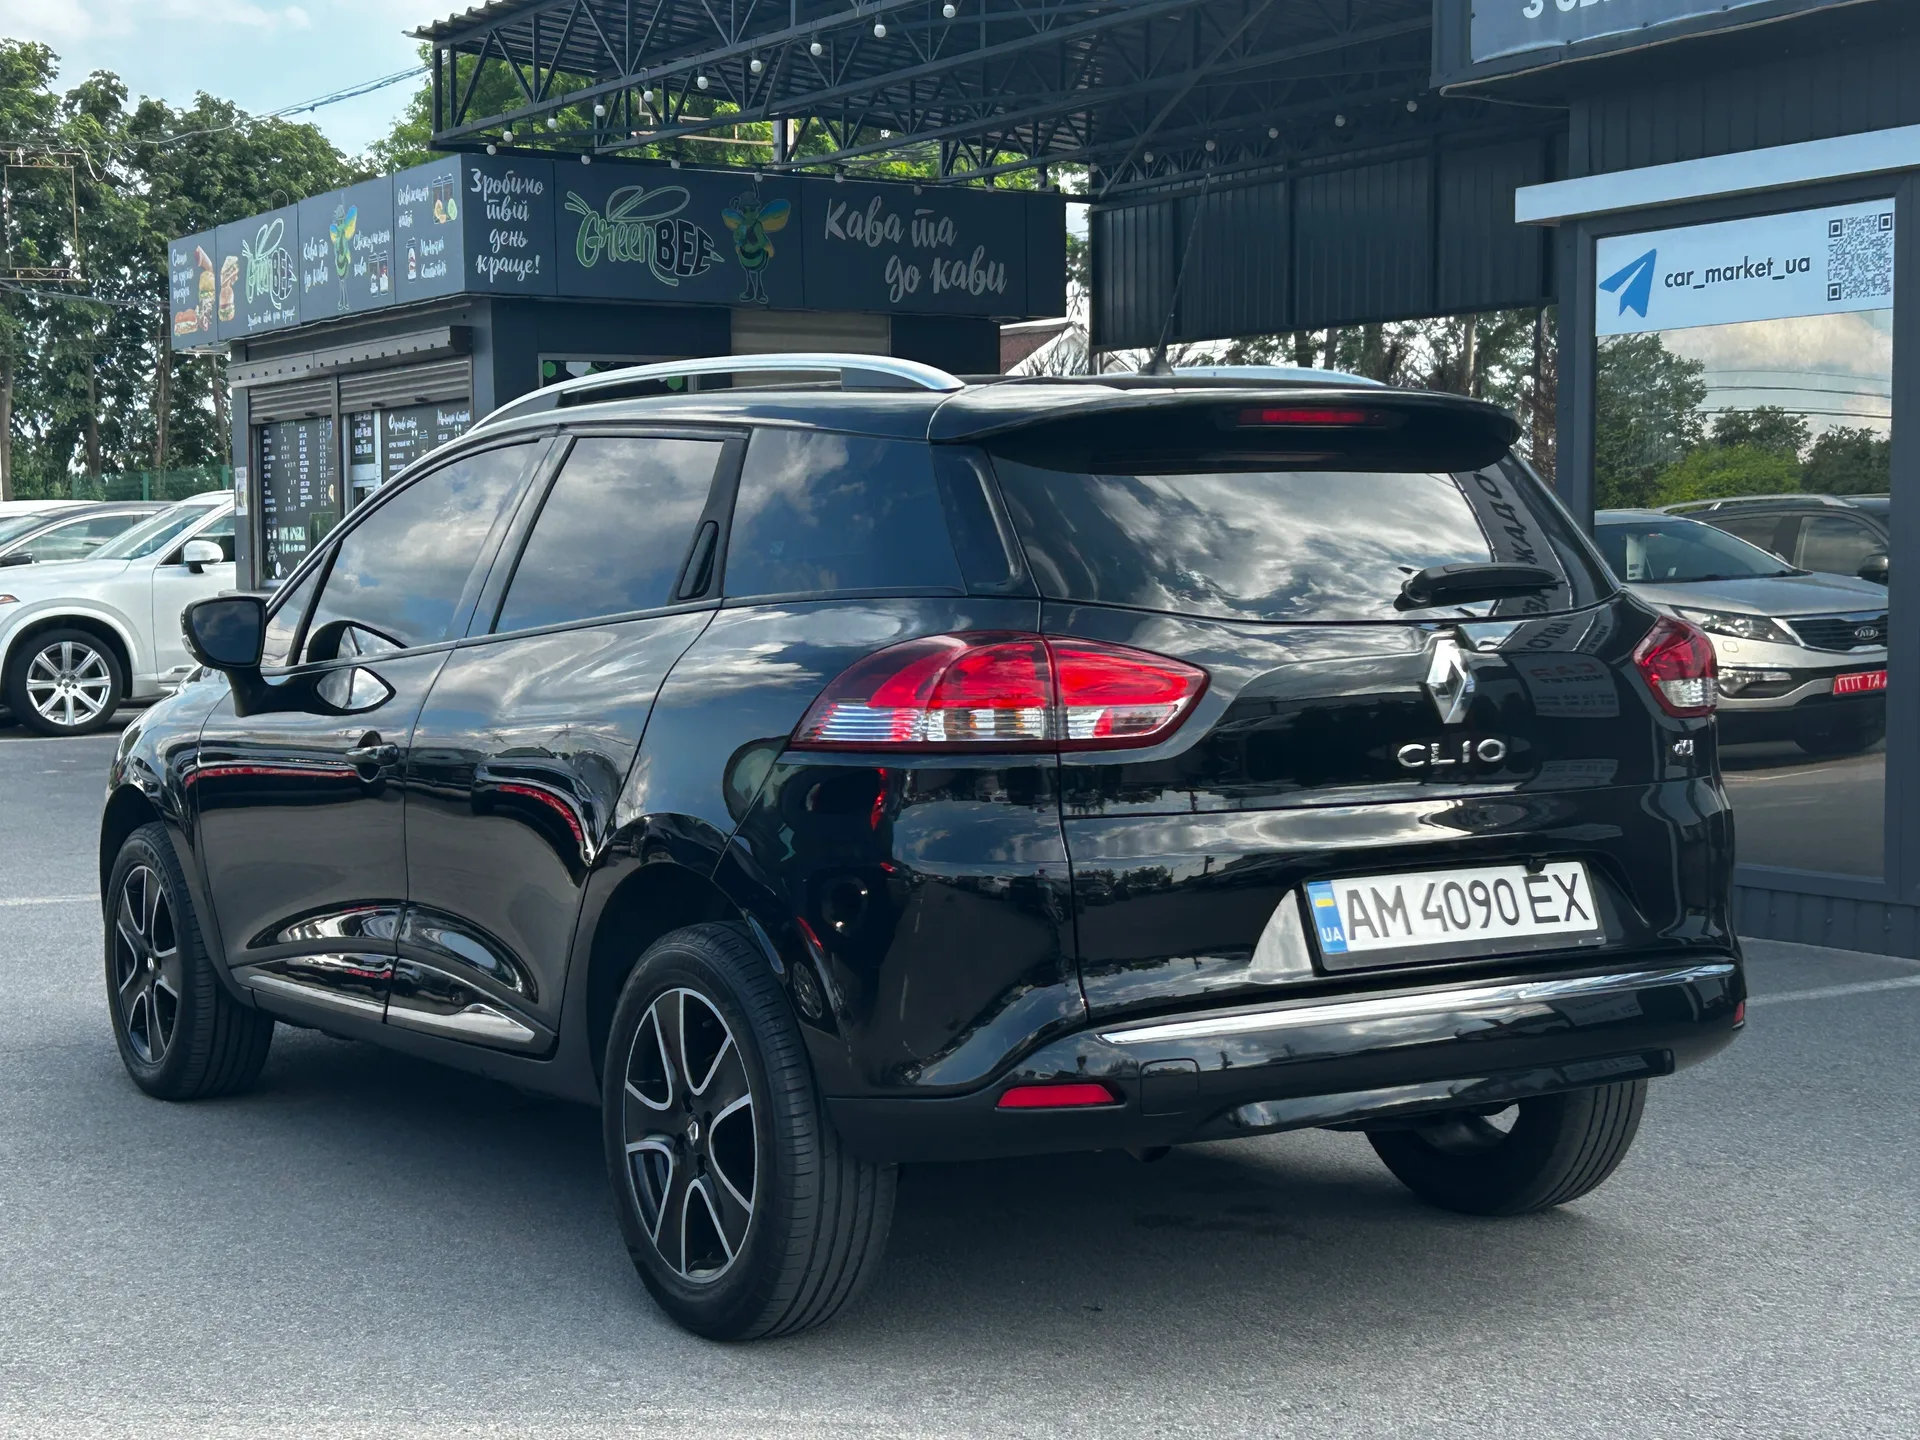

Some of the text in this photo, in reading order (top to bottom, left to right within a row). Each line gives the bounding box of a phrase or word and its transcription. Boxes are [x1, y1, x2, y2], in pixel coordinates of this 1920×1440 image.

[470, 167, 544, 202] Зробимо
[486, 195, 530, 221] твій
[824, 195, 958, 249] Кава та
[489, 228, 528, 254] день
[475, 254, 540, 283] краще!
[885, 244, 1008, 304] до кави
[1664, 255, 1811, 290] car_market_ua
[1397, 738, 1506, 768] CLIO
[1346, 873, 1591, 941] AM 4090 EX
[1321, 926, 1344, 943] UA
